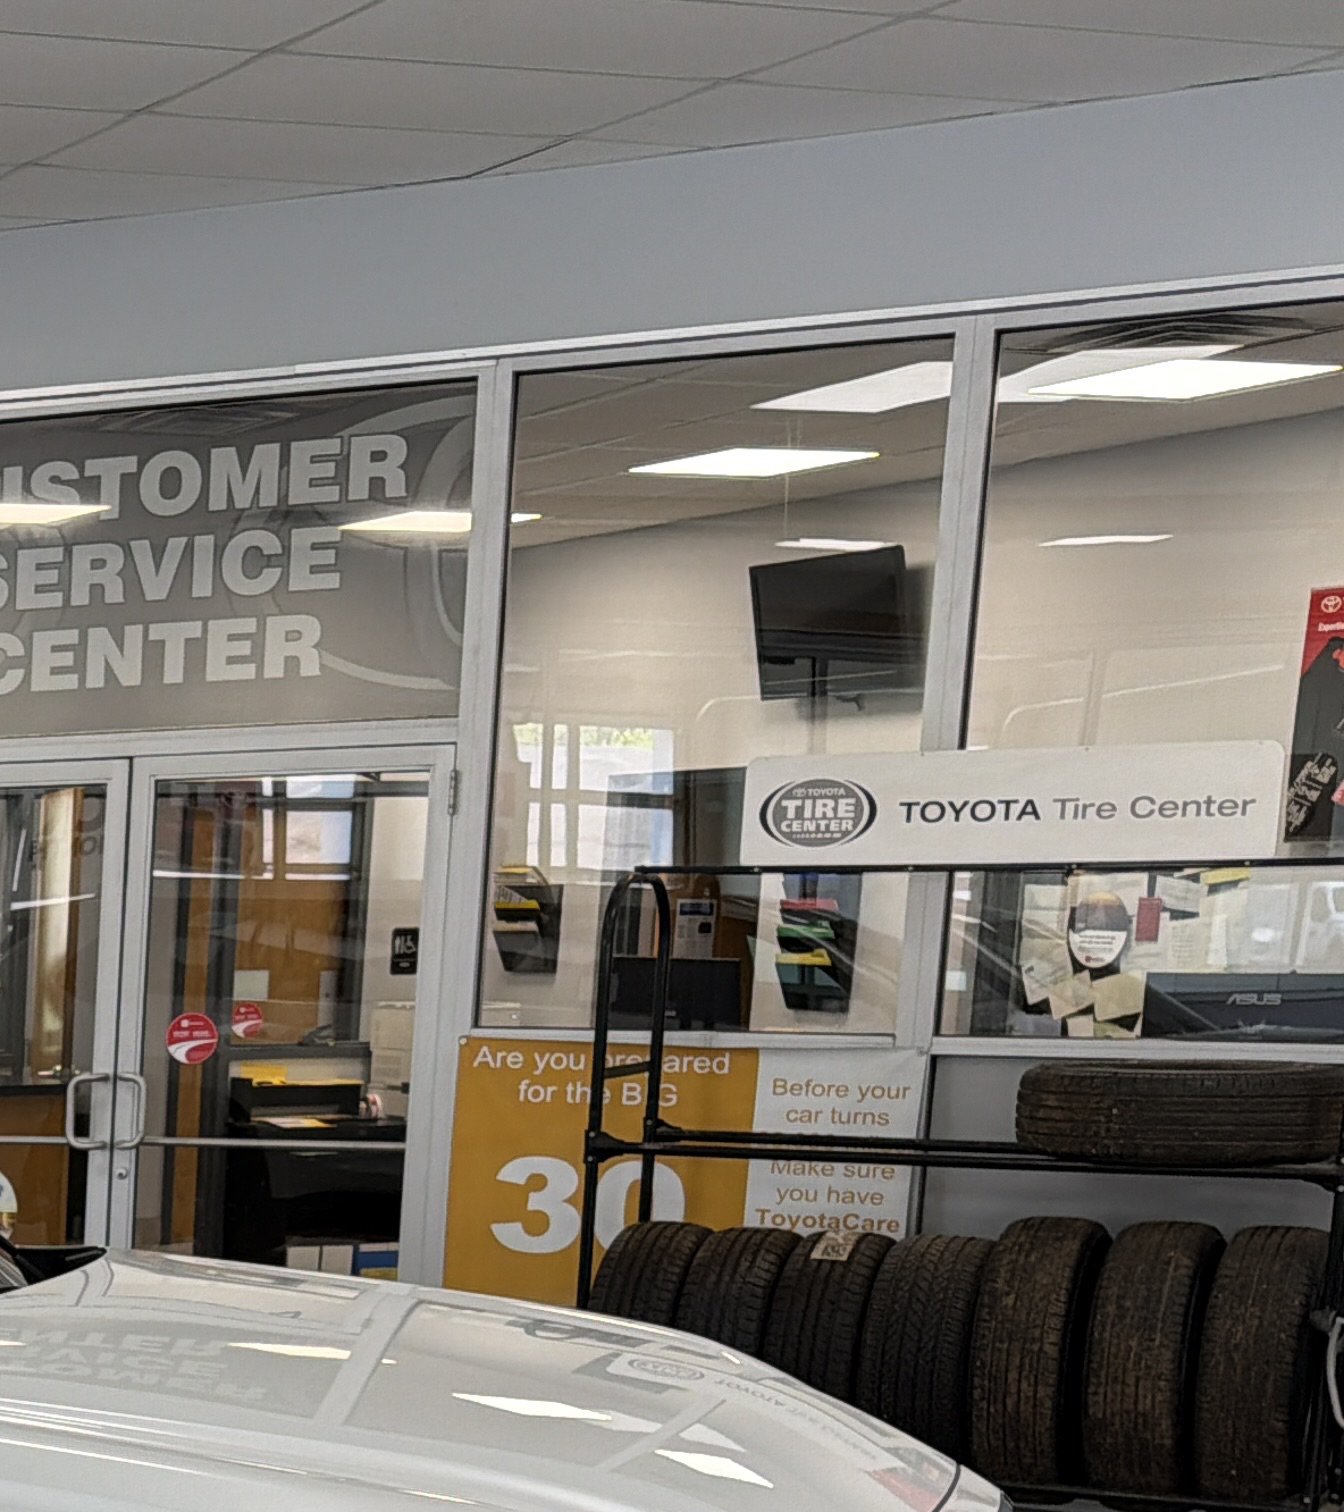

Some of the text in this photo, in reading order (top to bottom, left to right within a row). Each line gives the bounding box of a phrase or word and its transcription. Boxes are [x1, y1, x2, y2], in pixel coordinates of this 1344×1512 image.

[807, 787, 847, 797] TOYOTA
[780, 797, 857, 819] TIRE
[898, 794, 1257, 824] TOYOTA Tire Center
[780, 819, 855, 832] CENTER
[1226, 993, 1283, 1006] ASUS
[472, 1045, 731, 1077] Are you preared
[517, 1081, 555, 1105] for
[620, 1082, 680, 1108] BG
[771, 1077, 912, 1102] Before your
[784, 1108, 891, 1127] car turns
[769, 1160, 896, 1180] Make sure
[490, 1154, 686, 1255] 30
[775, 1186, 885, 1206] you have
[755, 1207, 901, 1233] ToyotaCare
